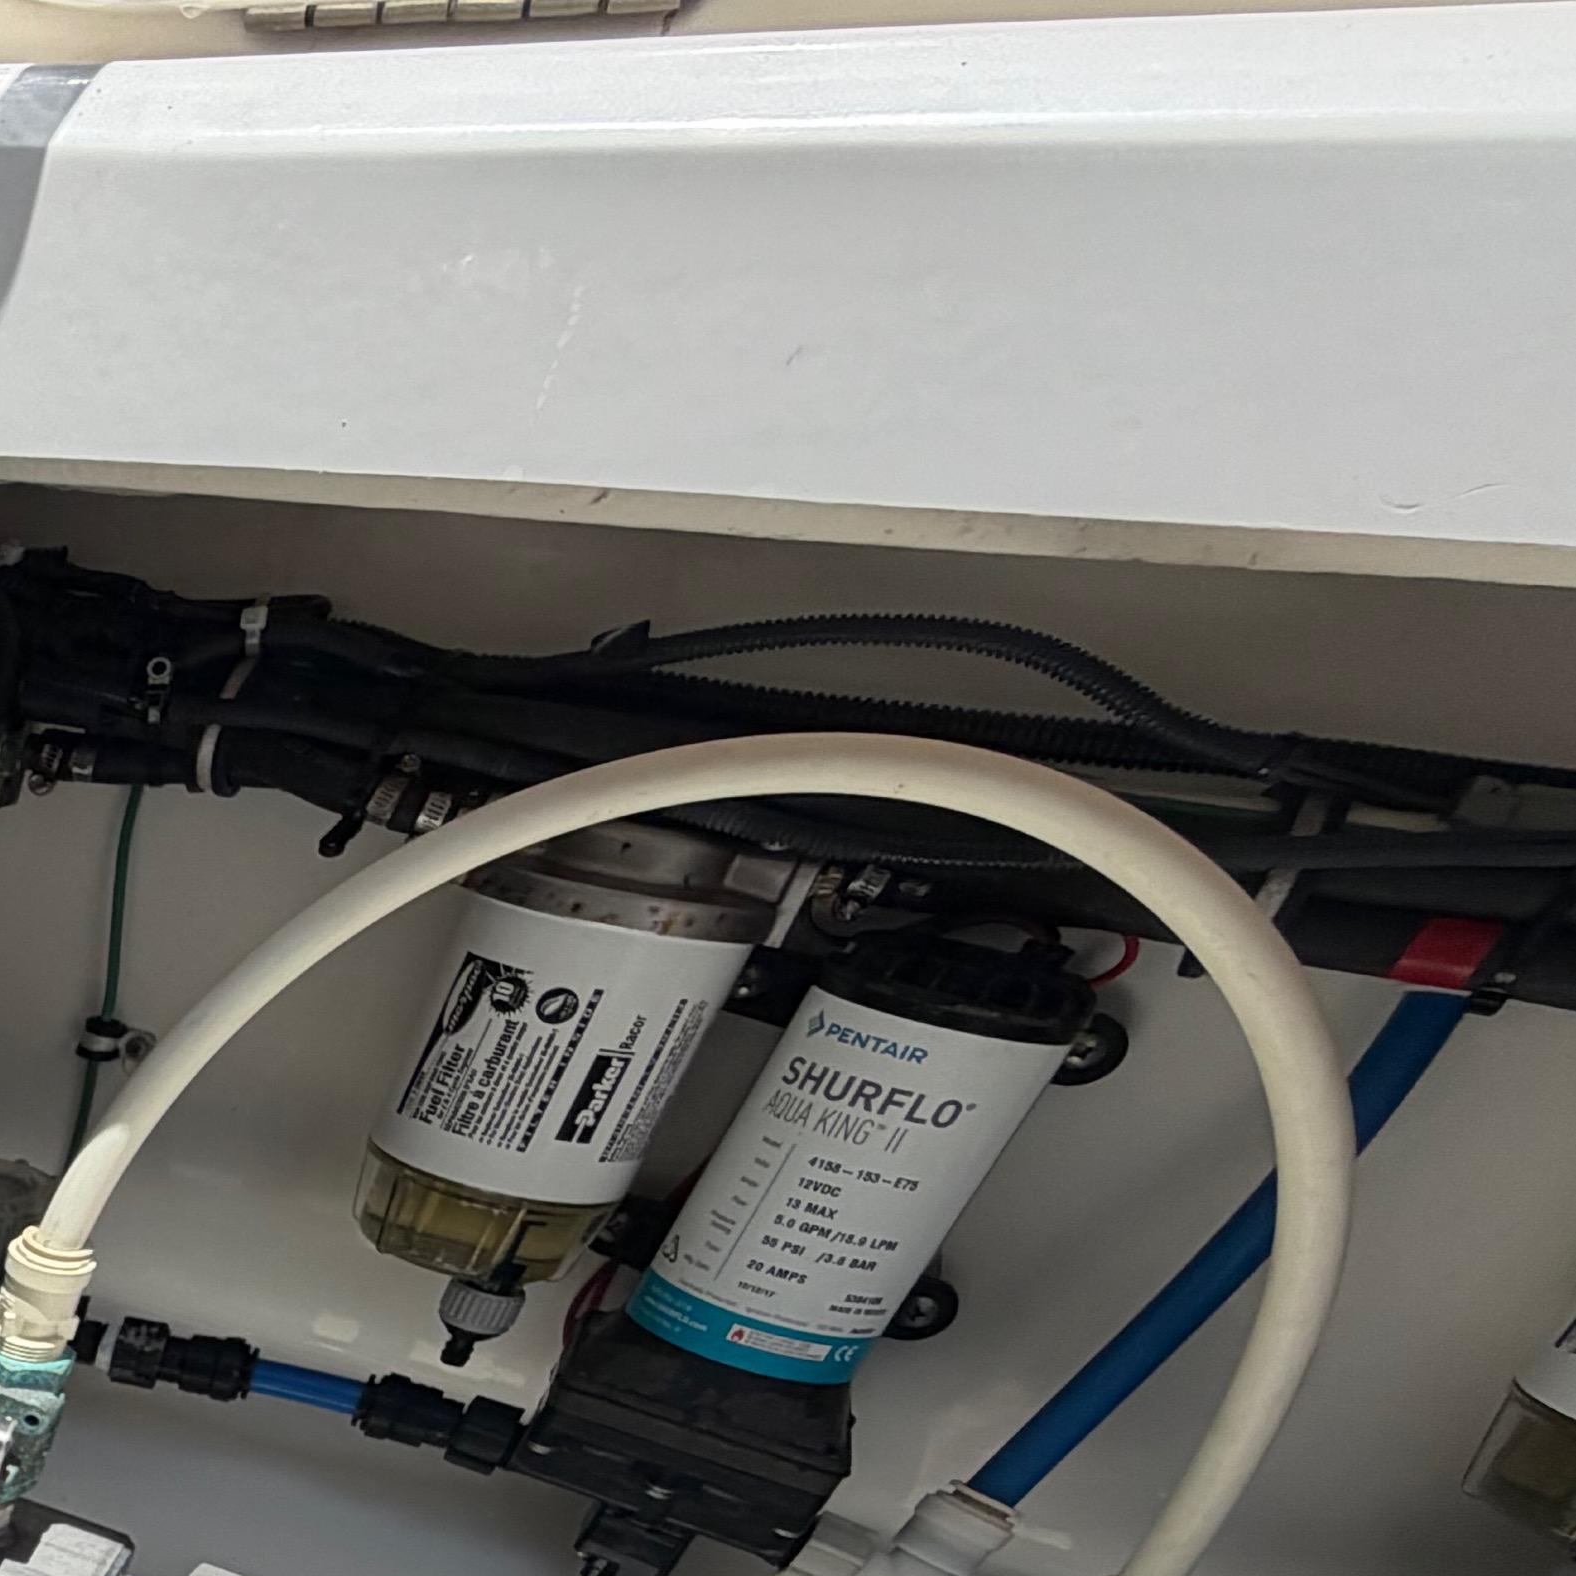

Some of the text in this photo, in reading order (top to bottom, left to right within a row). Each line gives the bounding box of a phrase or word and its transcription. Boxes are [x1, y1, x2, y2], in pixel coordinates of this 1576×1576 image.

[491, 981, 515, 1003] 10
[619, 1014, 647, 1049] Racor
[825, 1023, 928, 1064] PENTAIR
[419, 1089, 445, 1124] Fuel
[437, 1043, 466, 1087] Filter
[452, 1102, 480, 1136] Filtre
[478, 1018, 520, 1087] carburant
[575, 1057, 626, 1127] Parker
[763, 1090, 812, 1128] AQUA
[884, 1127, 909, 1153] II
[798, 1177, 842, 1198] 12VDC
[786, 1197, 838, 1220] 13 MAX
[774, 1214, 796, 1228] 5.0
[799, 1222, 832, 1241] GPM
[870, 1238, 898, 1252] LPM
[746, 1259, 808, 1285] 20 AMPS
[761, 1235, 779, 1248] 55
[781, 1241, 806, 1256] PSI
[848, 1258, 877, 1272] BAR
